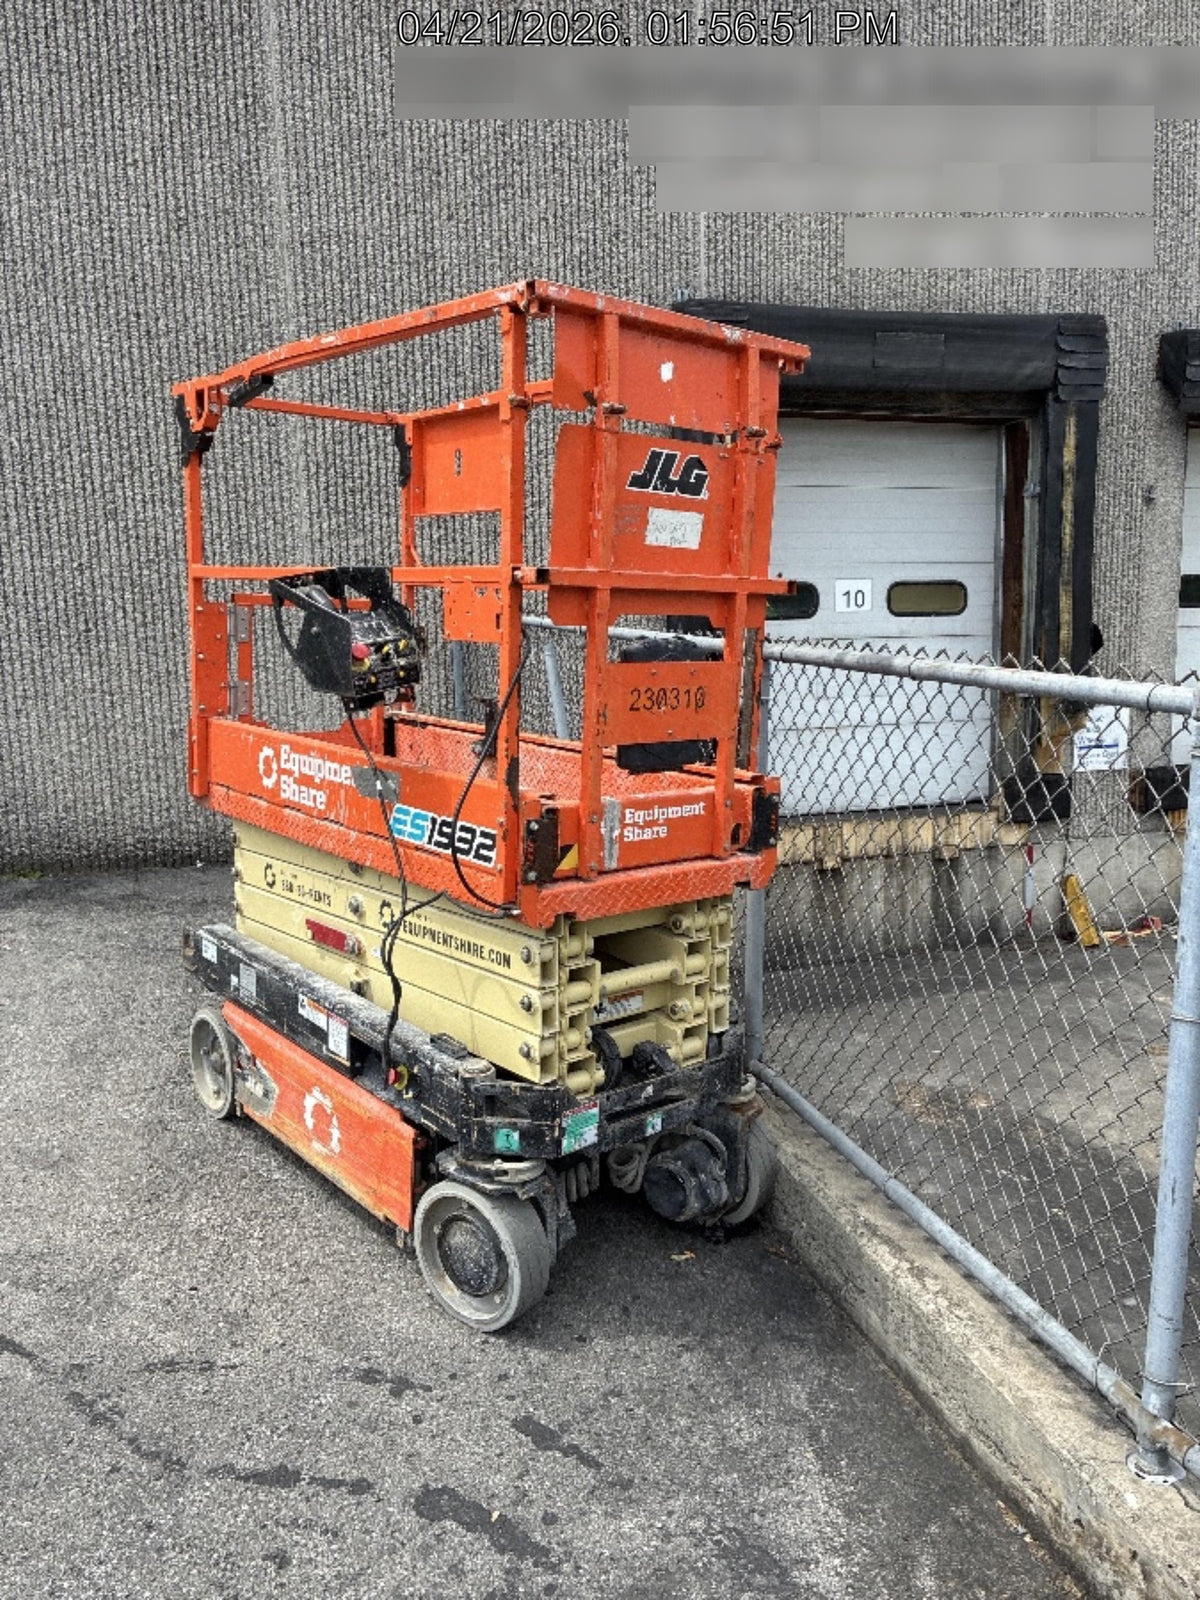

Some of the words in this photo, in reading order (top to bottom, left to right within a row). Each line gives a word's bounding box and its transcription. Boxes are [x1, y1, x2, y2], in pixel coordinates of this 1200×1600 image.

[626, 448, 709, 500] JLG
[842, 589, 865, 609] 10
[629, 685, 705, 713] 230310
[279, 743, 355, 787] Equipme
[279, 774, 327, 810] Share
[624, 801, 706, 825] Equipment
[390, 805, 497, 866] ES1932
[623, 825, 668, 842] Share
[402, 920, 511, 969] EQUIPMENTSHARE.COM
